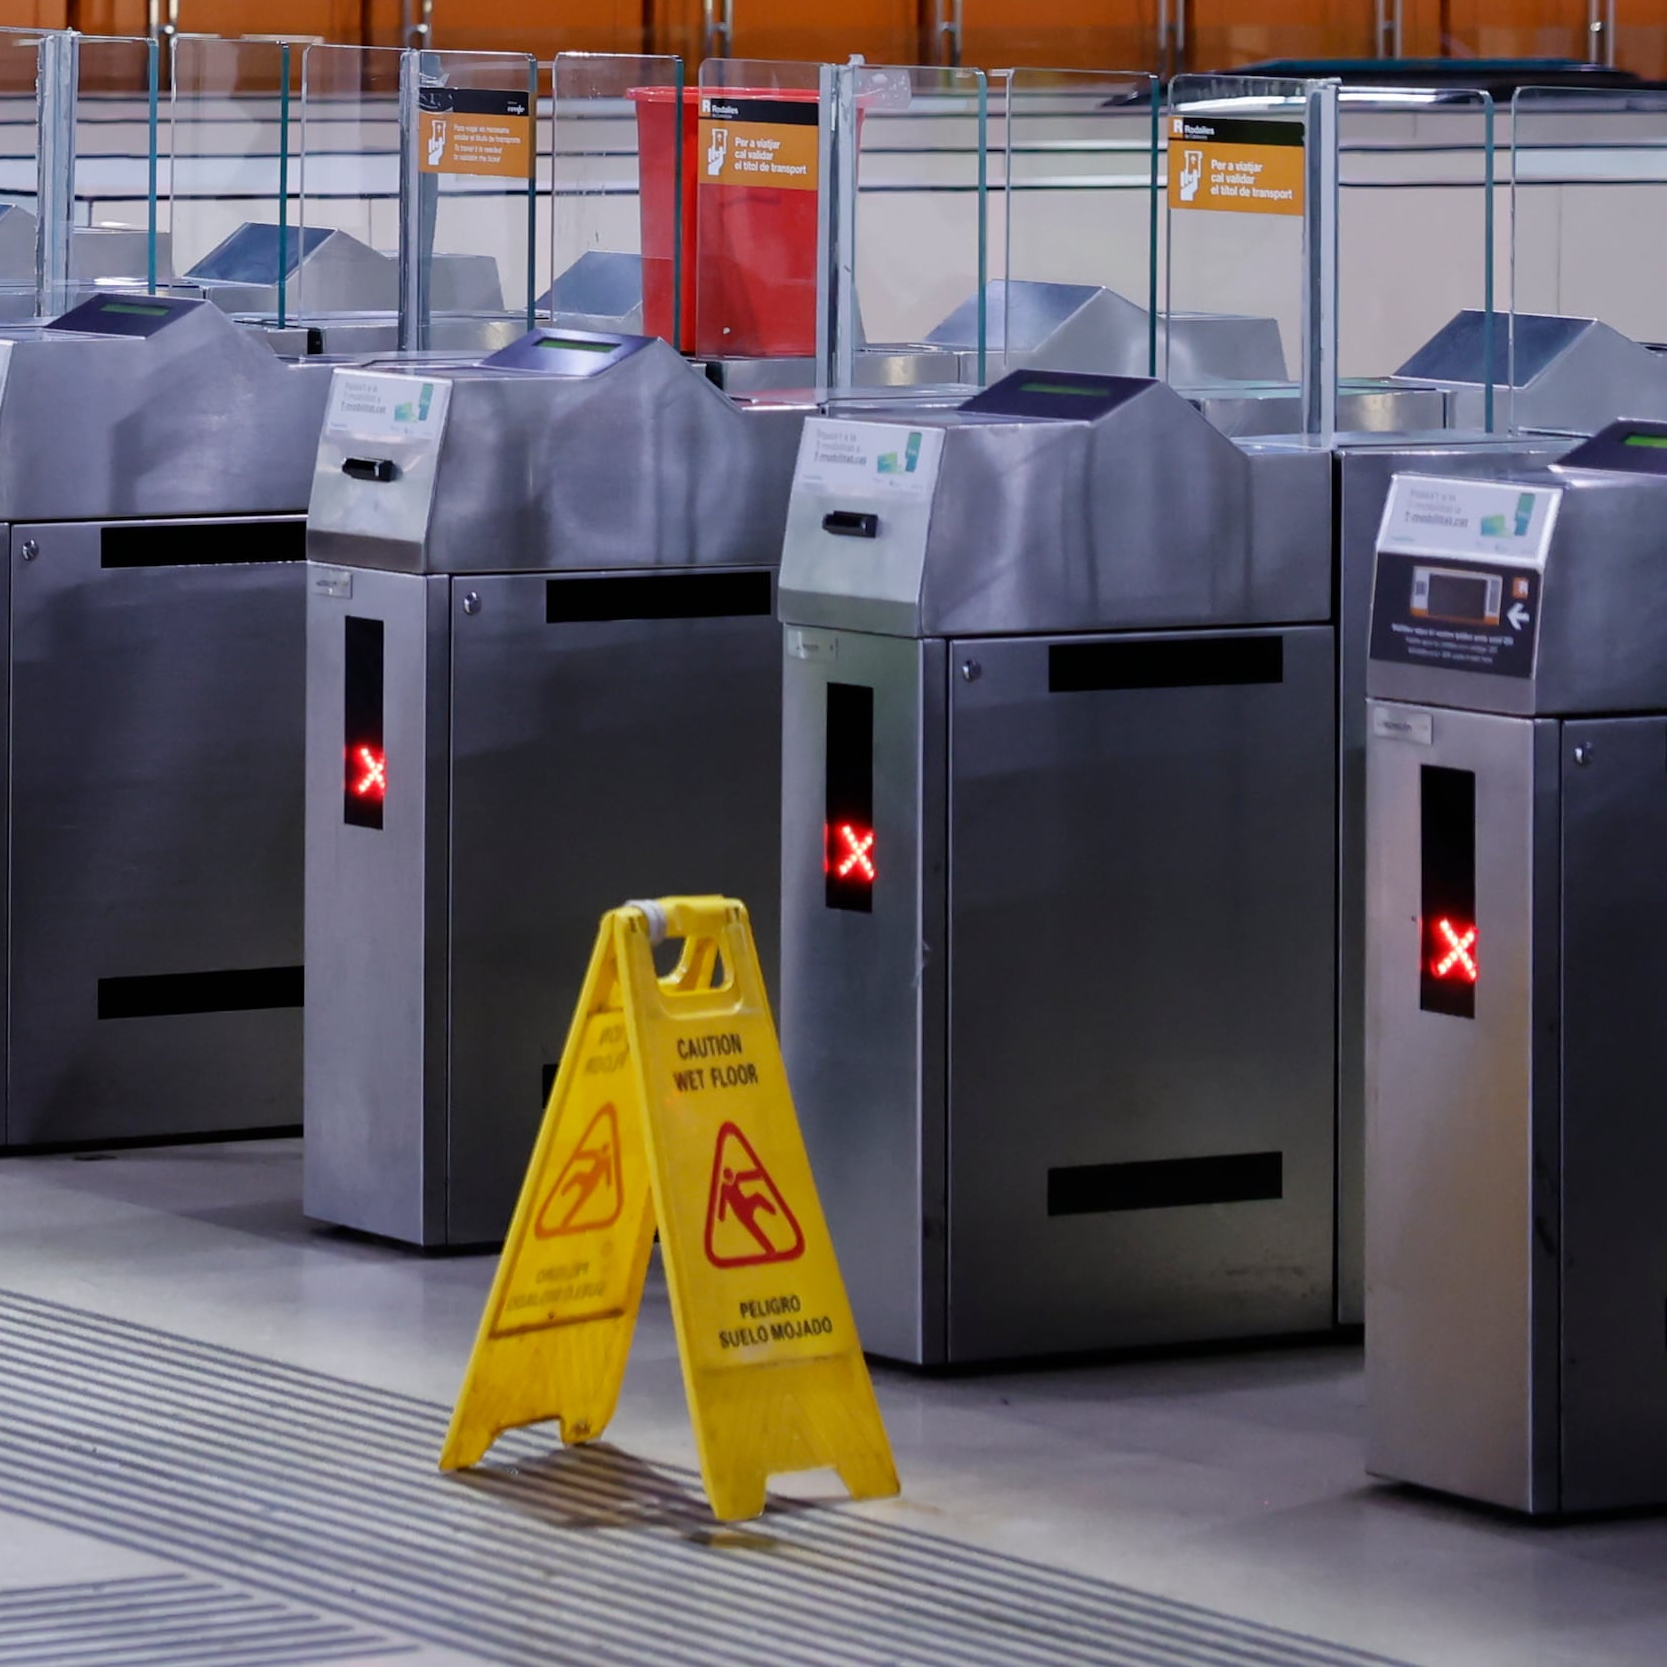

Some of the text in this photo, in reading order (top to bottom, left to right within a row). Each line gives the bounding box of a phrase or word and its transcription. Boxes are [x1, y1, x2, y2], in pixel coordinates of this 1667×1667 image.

[1184, 124, 1215, 135] Rodalies
[735, 136, 780, 151] Per a viatjar
[734, 149, 774, 161] cal validar
[734, 160, 742, 170] el
[759, 161, 769, 172] de
[770, 162, 807, 176] transport
[1211, 159, 1263, 174] Per a viatjar
[1210, 172, 1255, 185] cal validar
[1210, 184, 1219, 195] el
[1239, 186, 1251, 197] de
[1252, 187, 1293, 201] transport
[677, 1033, 742, 1060] CAUTION
[673, 1063, 758, 1093] WET FLOOR
[740, 1294, 801, 1319] PELIGRO
[719, 1315, 832, 1349] SUELO MOJADO
